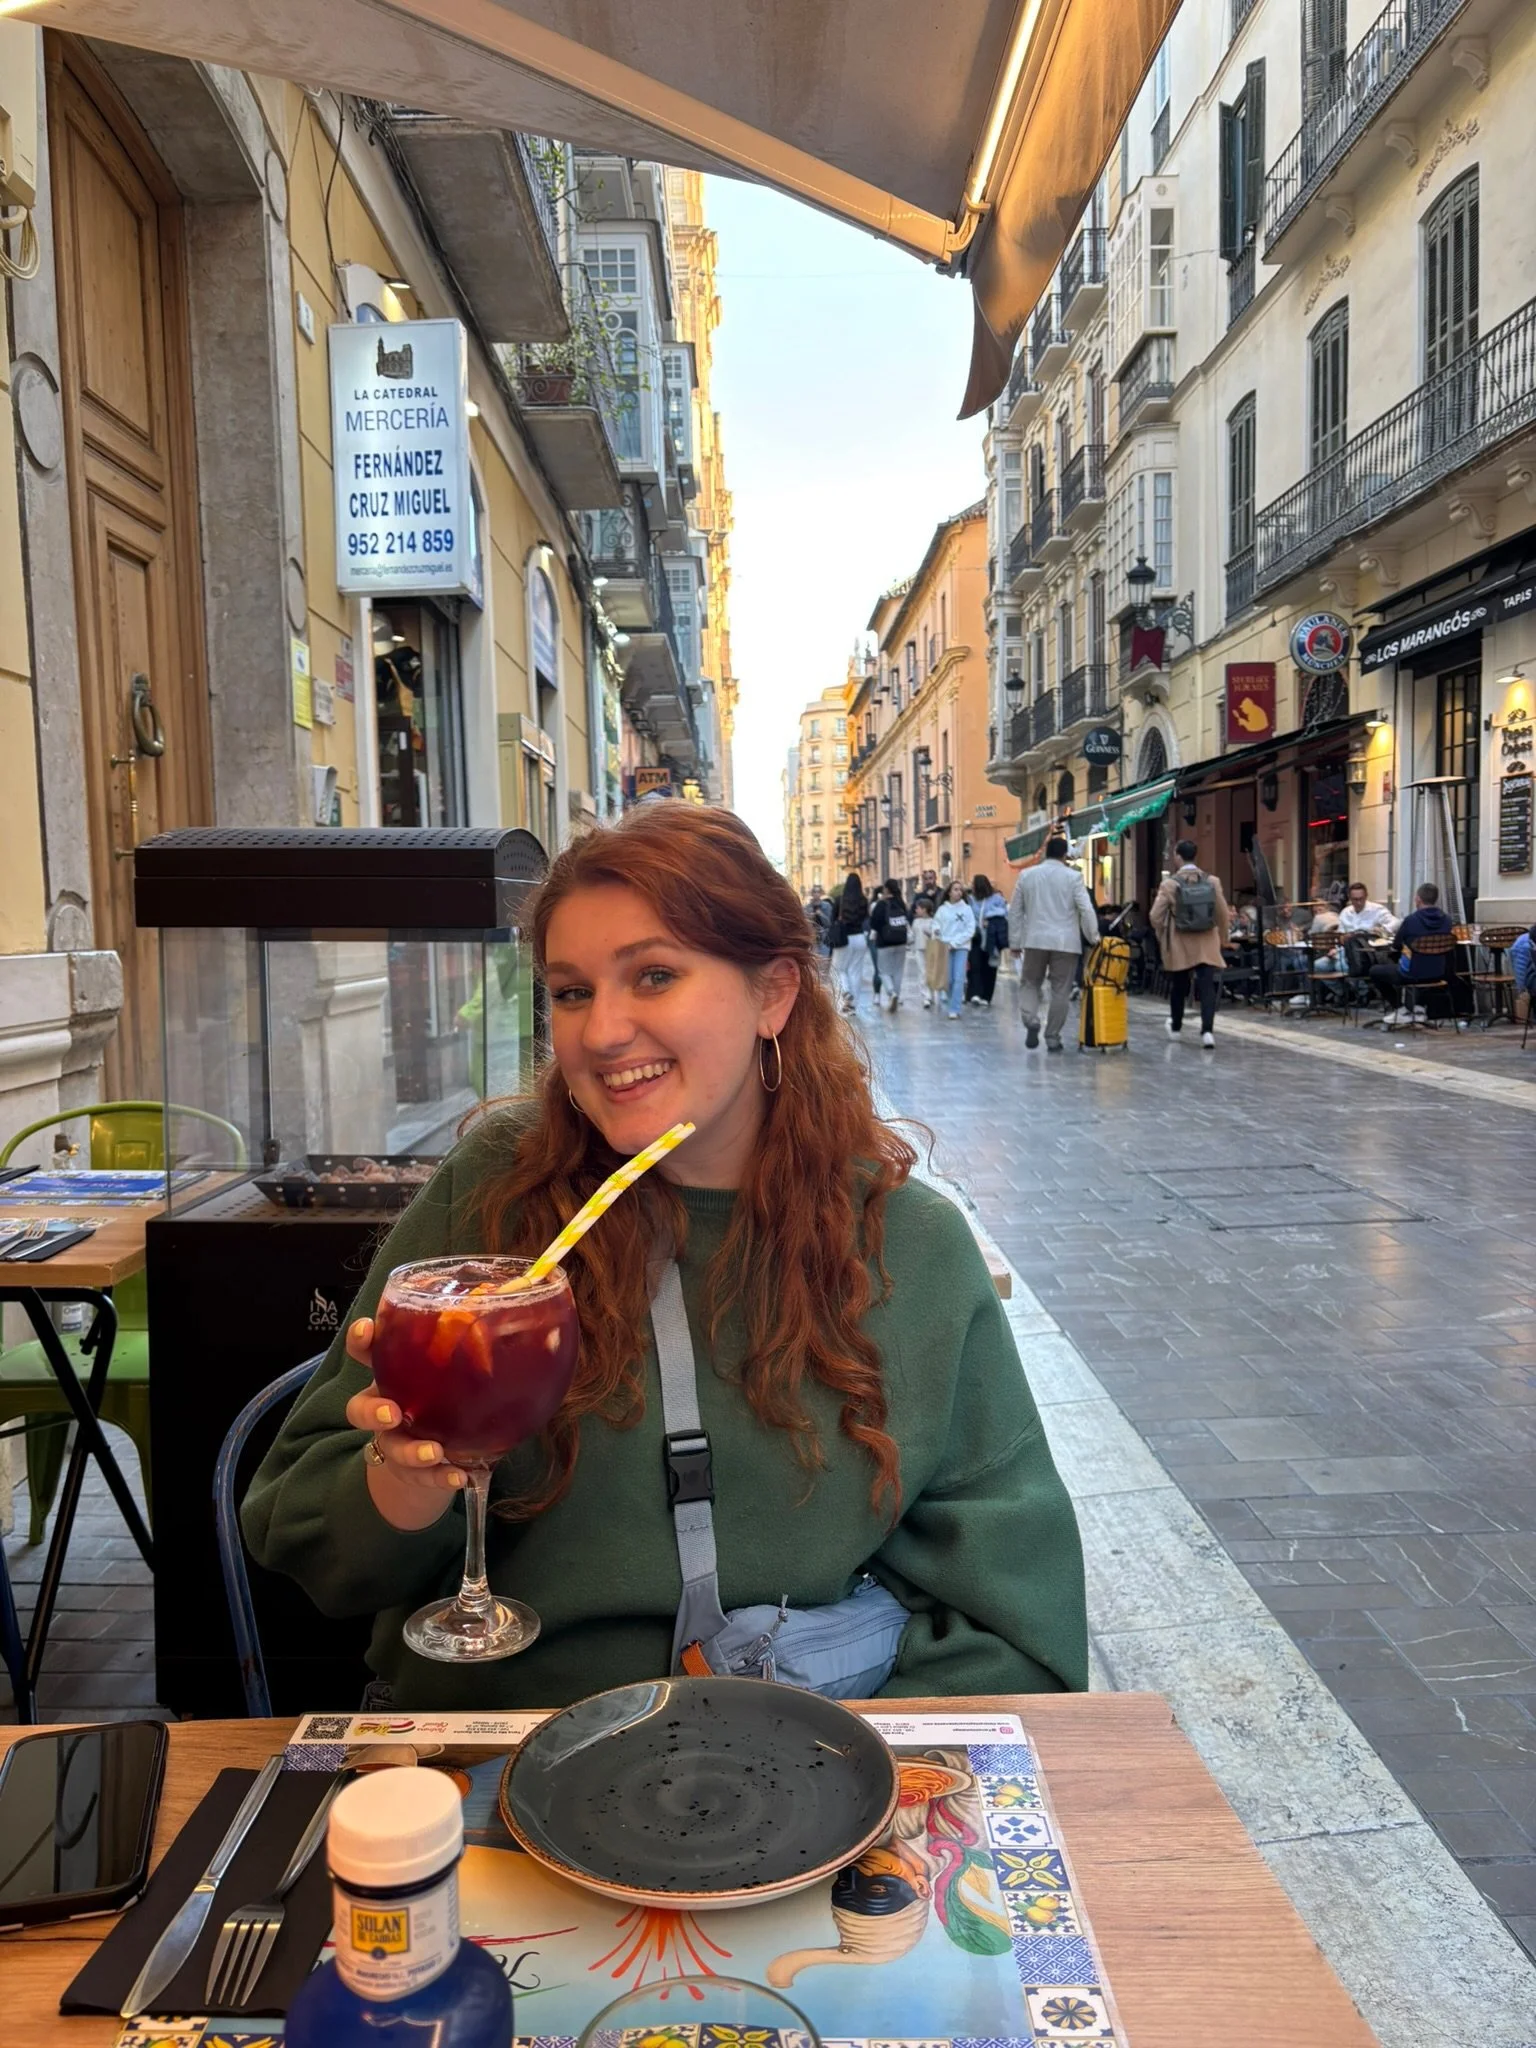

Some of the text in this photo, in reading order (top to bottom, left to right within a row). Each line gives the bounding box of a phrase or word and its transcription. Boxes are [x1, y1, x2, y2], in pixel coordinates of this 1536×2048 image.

[354, 386, 439, 401] LA CATEDRAL
[345, 402, 450, 432] MERCERÍA
[354, 445, 444, 479] FERNÁNDEZ
[349, 488, 451, 518] CRUZ MIGUEL
[348, 528, 454, 556] 952 214 859
[1503, 588, 1533, 609] TAPAS
[1297, 615, 1350, 643] PAULANER
[1376, 609, 1472, 663] LOS MARANGÓS
[1501, 725, 1533, 743] Tapas
[638, 772, 669, 785] ATM
[309, 1312, 339, 1326] GAS
[356, 1913, 402, 1933] SOLAN
